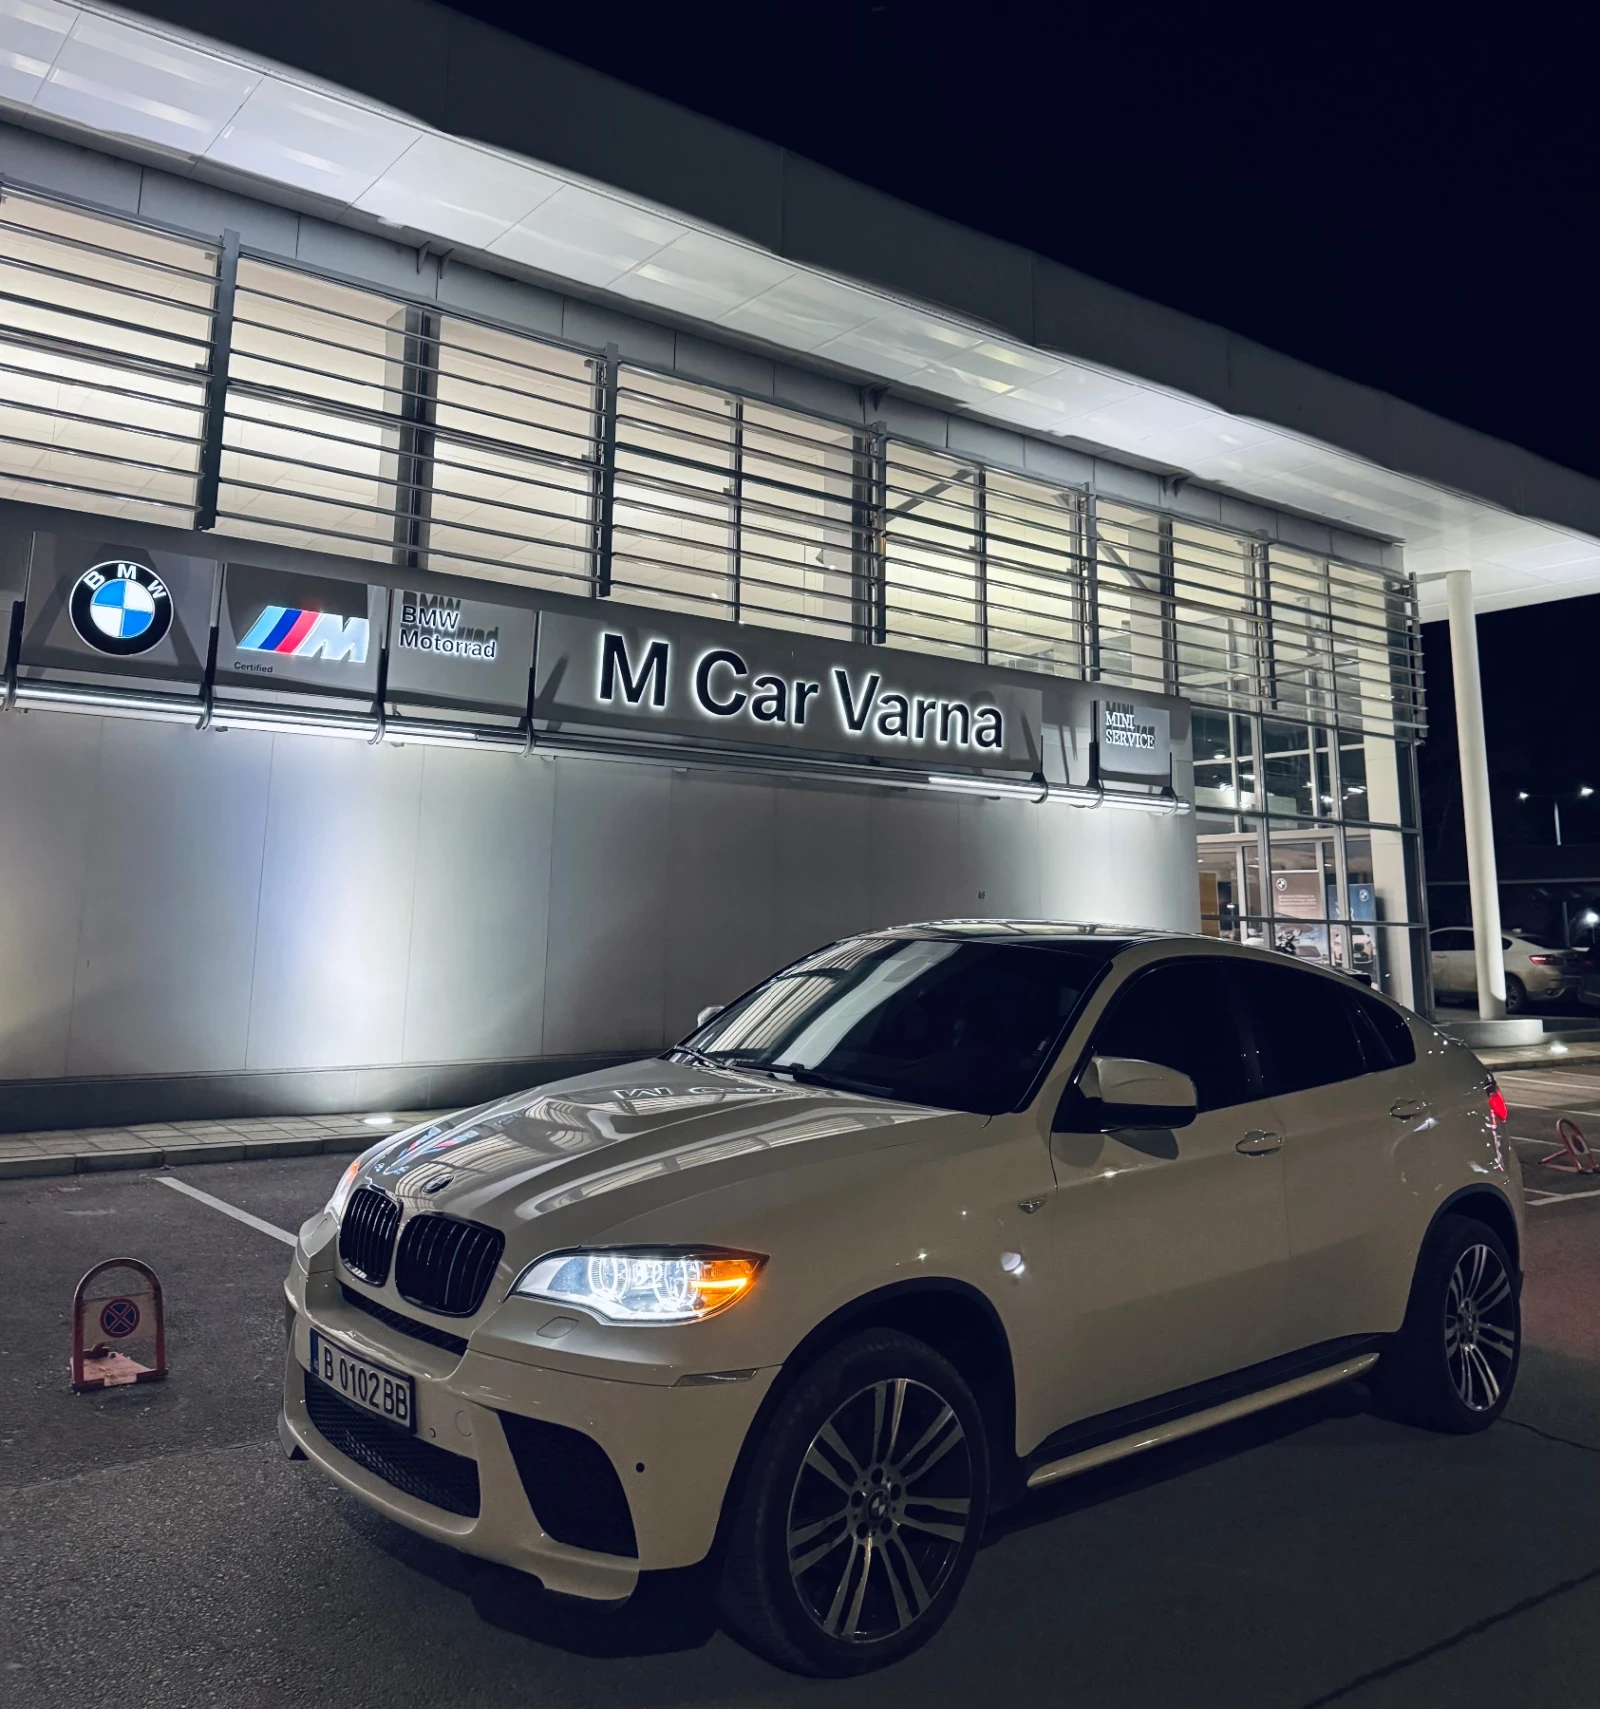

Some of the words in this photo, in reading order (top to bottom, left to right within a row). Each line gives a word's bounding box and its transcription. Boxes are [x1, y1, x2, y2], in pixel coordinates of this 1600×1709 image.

[83, 563, 167, 599] BMW
[402, 605, 459, 630] BMW
[400, 629, 496, 658] Motorrad
[234, 661, 273, 673] Certified
[599, 633, 670, 707] M
[695, 649, 820, 725] Car
[833, 669, 1004, 749] Varna
[1105, 711, 1135, 729] MINI
[1105, 729, 1155, 749] SERVICE
[324, 1346, 334, 1381] B
